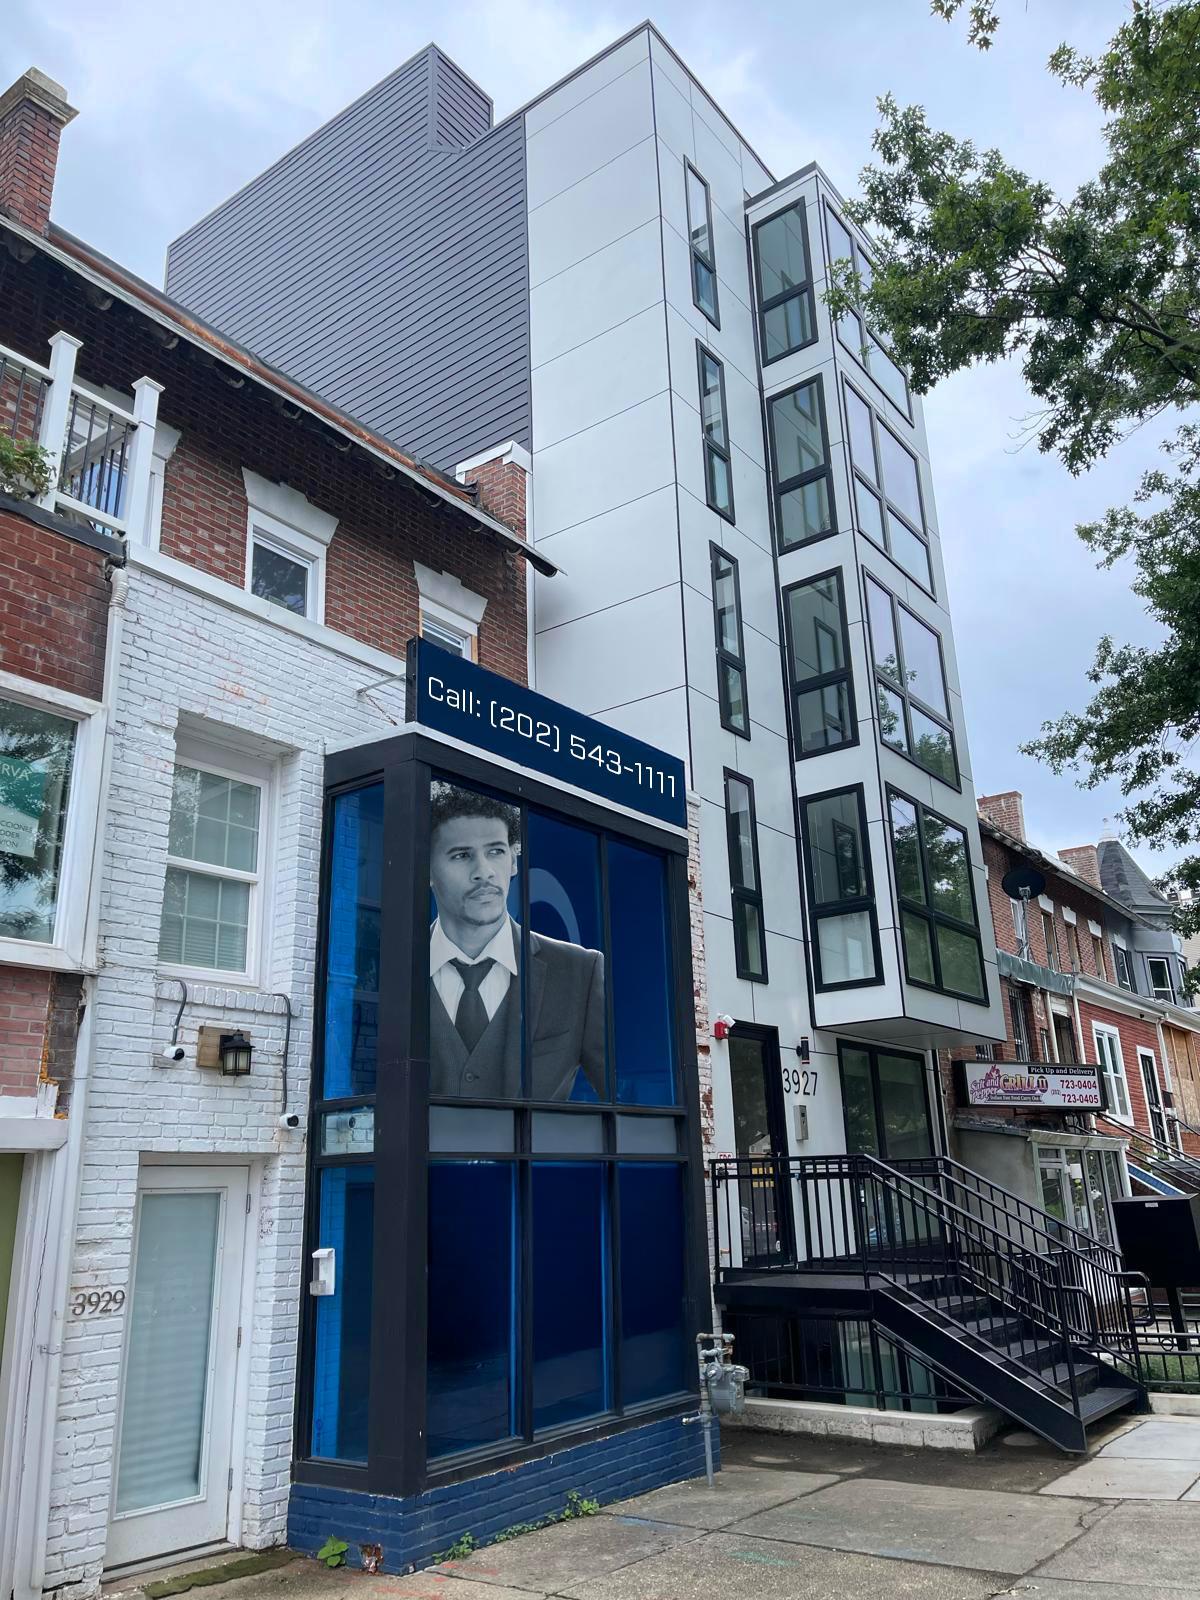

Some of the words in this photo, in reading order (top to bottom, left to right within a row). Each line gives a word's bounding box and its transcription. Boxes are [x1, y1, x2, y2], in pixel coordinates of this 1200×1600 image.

[428, 676, 481, 718] Call:
[490, 700, 560, 752] (202)
[570, 734, 676, 797] 543-1111
[1069, 1068, 1094, 1076] Delivery
[782, 1068, 818, 1096] 3927
[1060, 1080, 1097, 1090] 723-0404
[1062, 1093, 1099, 1104] 723-0405
[72, 1290, 126, 1316] 3929
